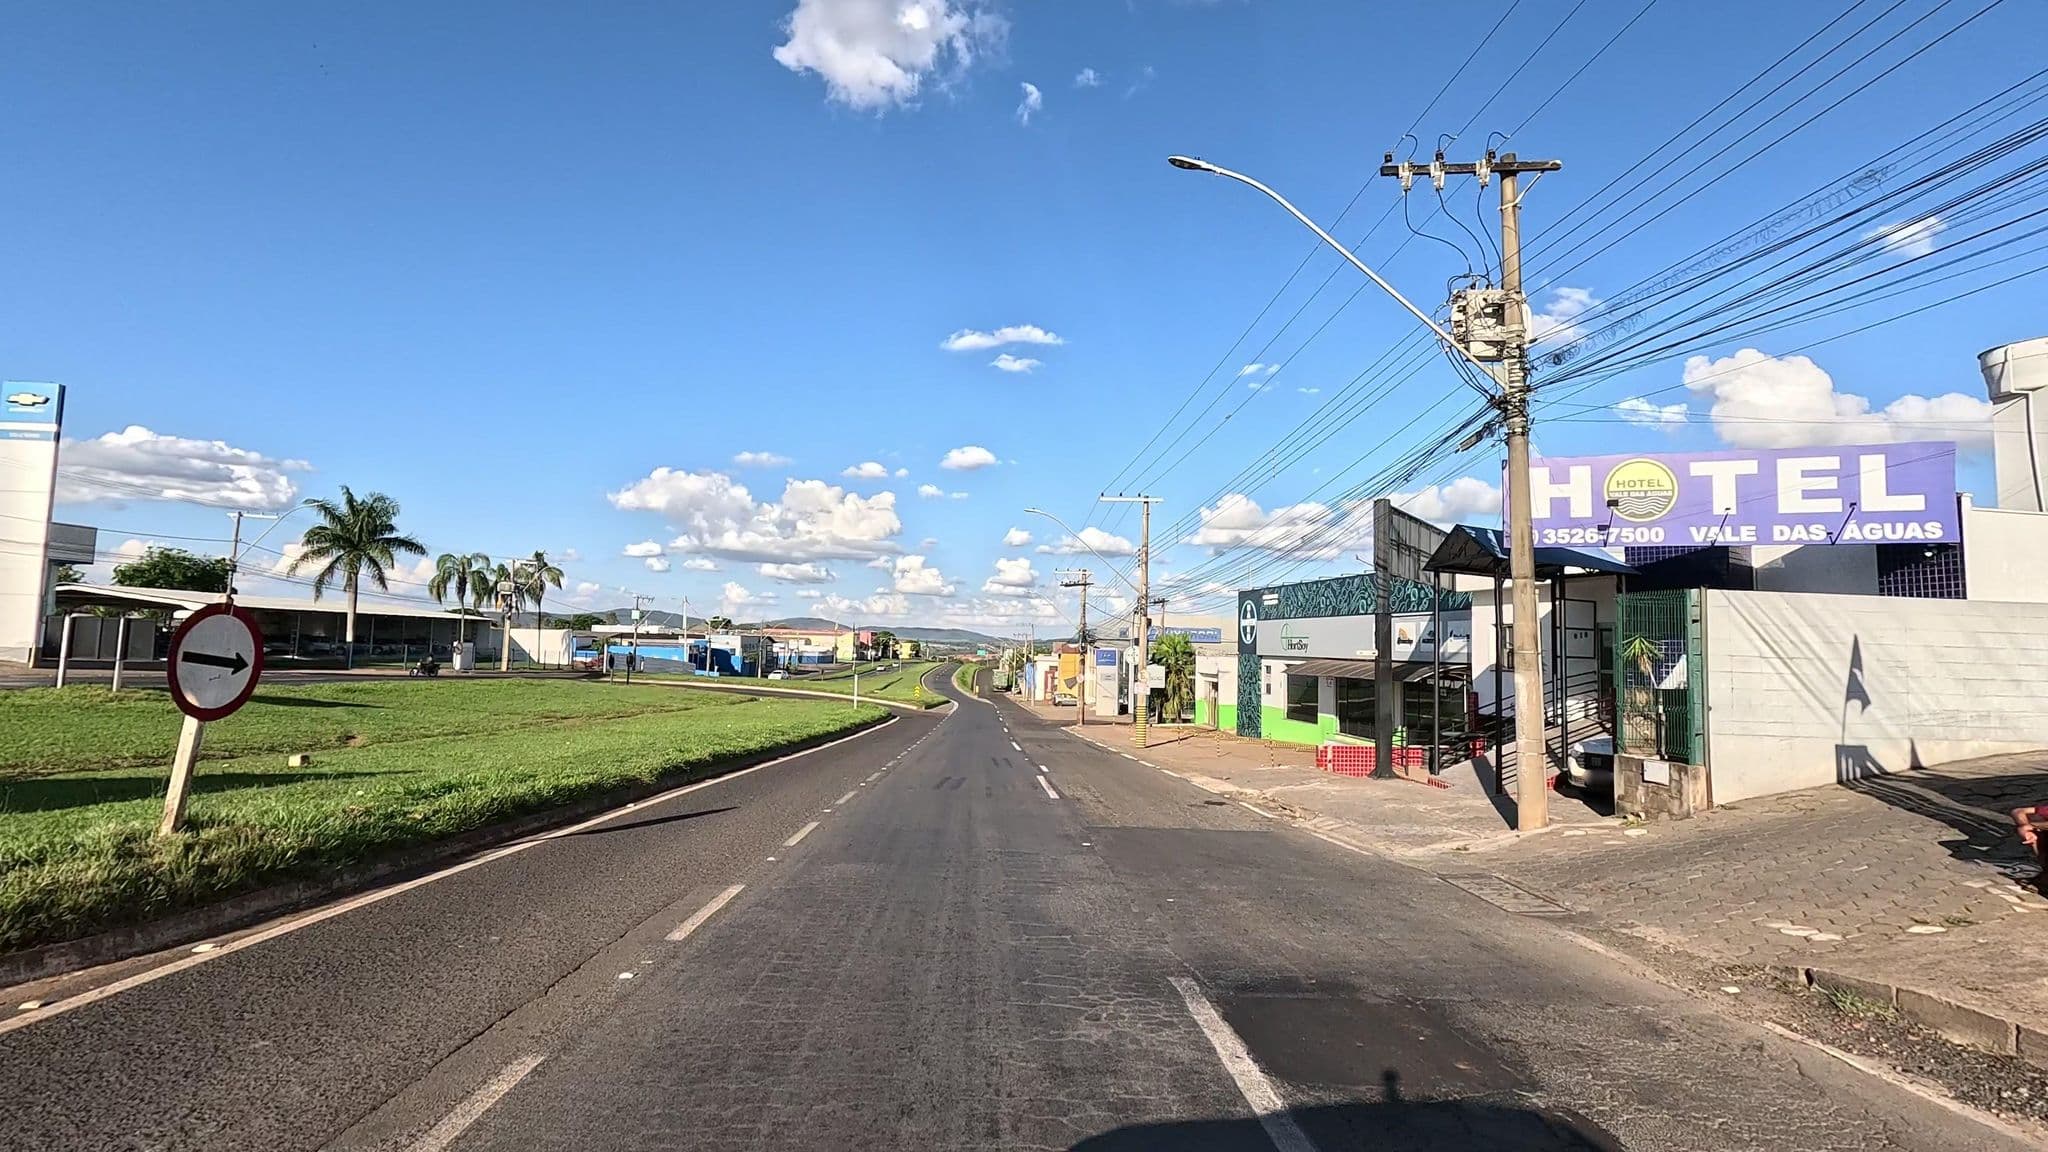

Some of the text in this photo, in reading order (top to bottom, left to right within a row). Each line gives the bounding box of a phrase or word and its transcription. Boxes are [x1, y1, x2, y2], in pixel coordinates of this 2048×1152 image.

[1616, 479, 1665, 489] HOTEL
[1689, 524, 1757, 543] VALE
[1773, 524, 1828, 542] DAS
[1842, 520, 1944, 542] ÁGUAS
